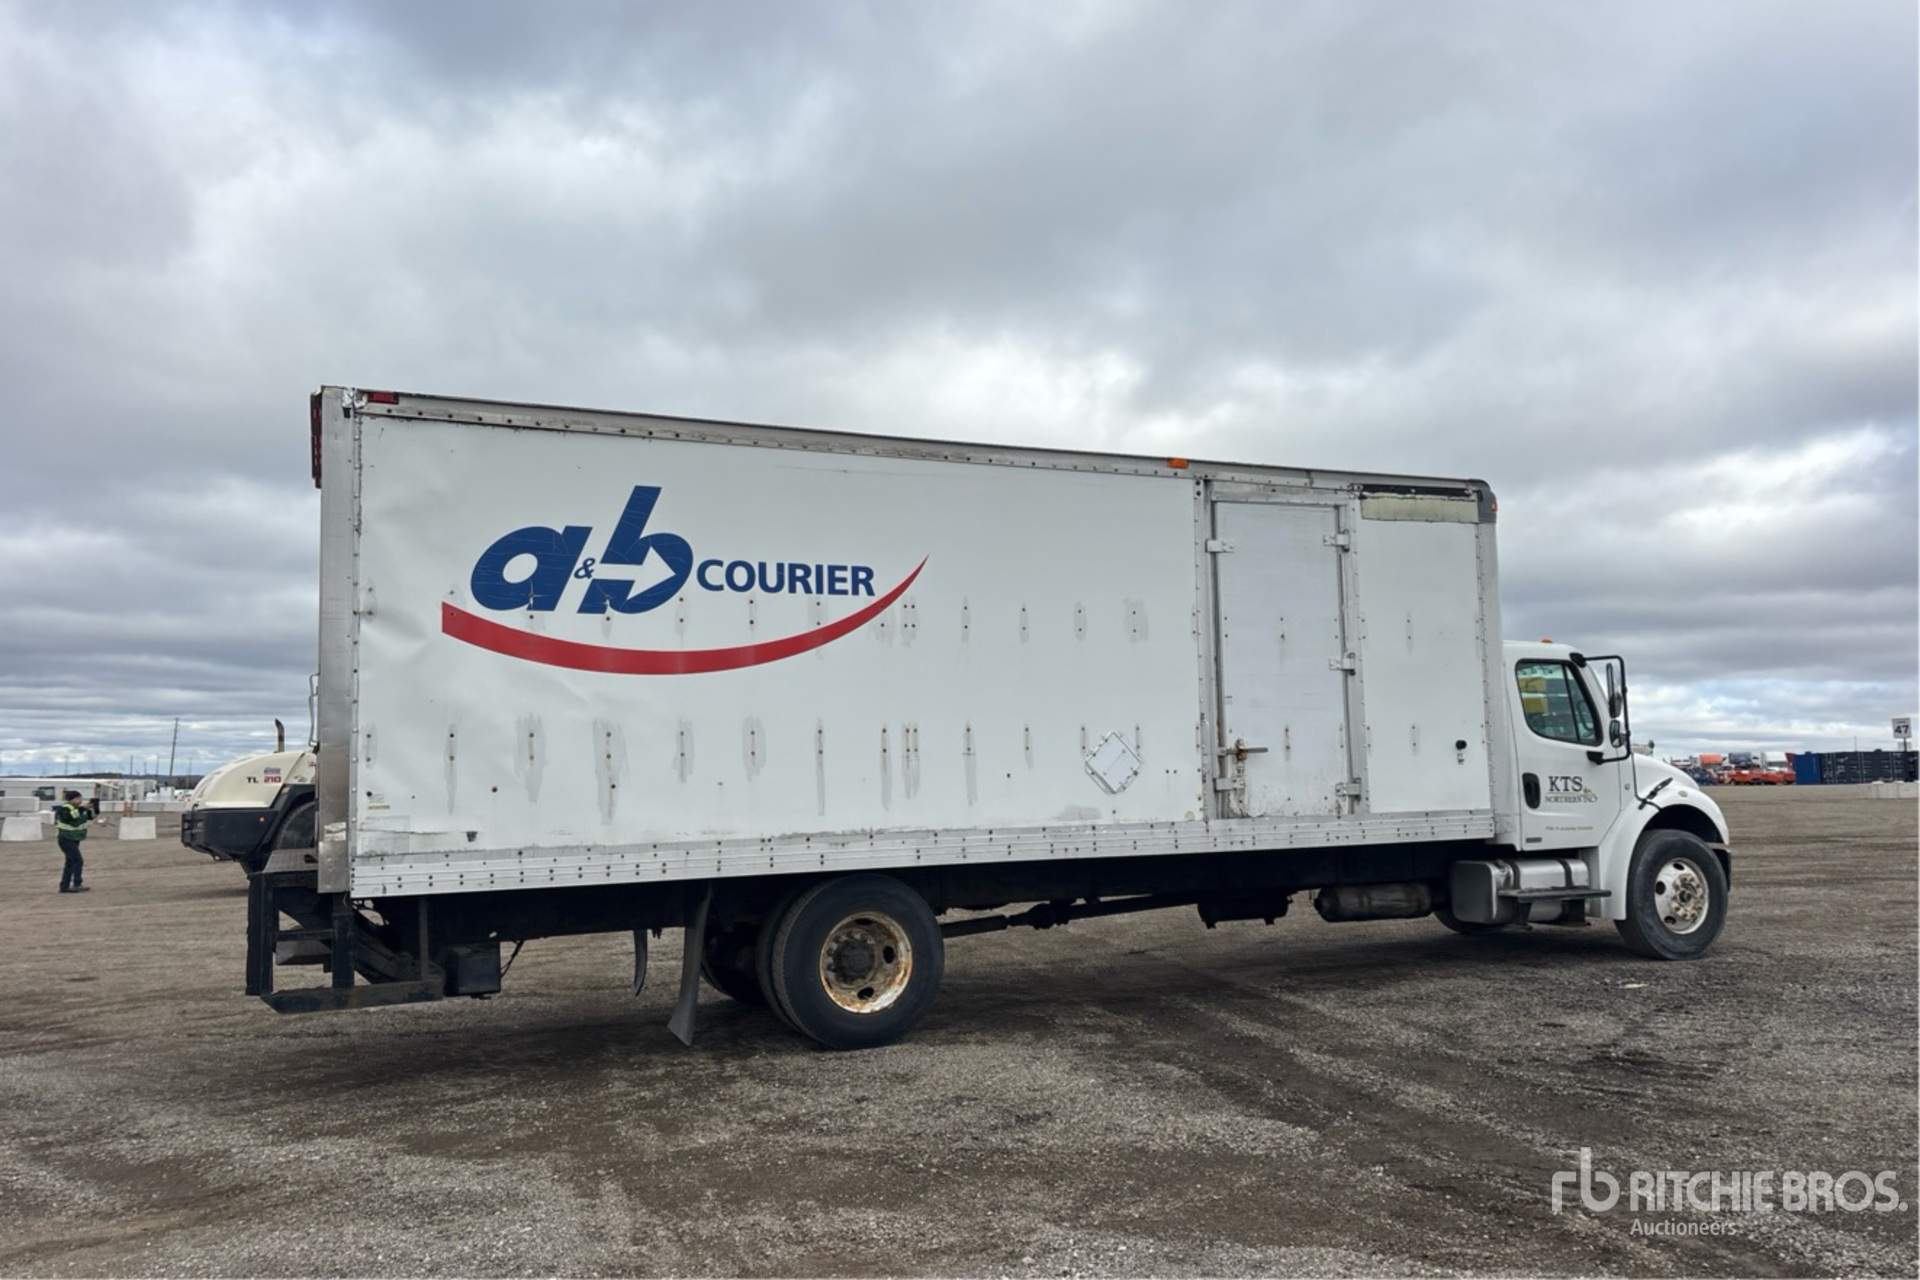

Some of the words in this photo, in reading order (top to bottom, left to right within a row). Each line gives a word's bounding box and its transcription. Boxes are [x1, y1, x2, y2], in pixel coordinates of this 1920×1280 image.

[697, 558, 876, 597] COURIER
[1894, 725, 1909, 734] 47
[1548, 776, 1583, 792] KTS
[1545, 795, 1582, 804] NORTHERN
